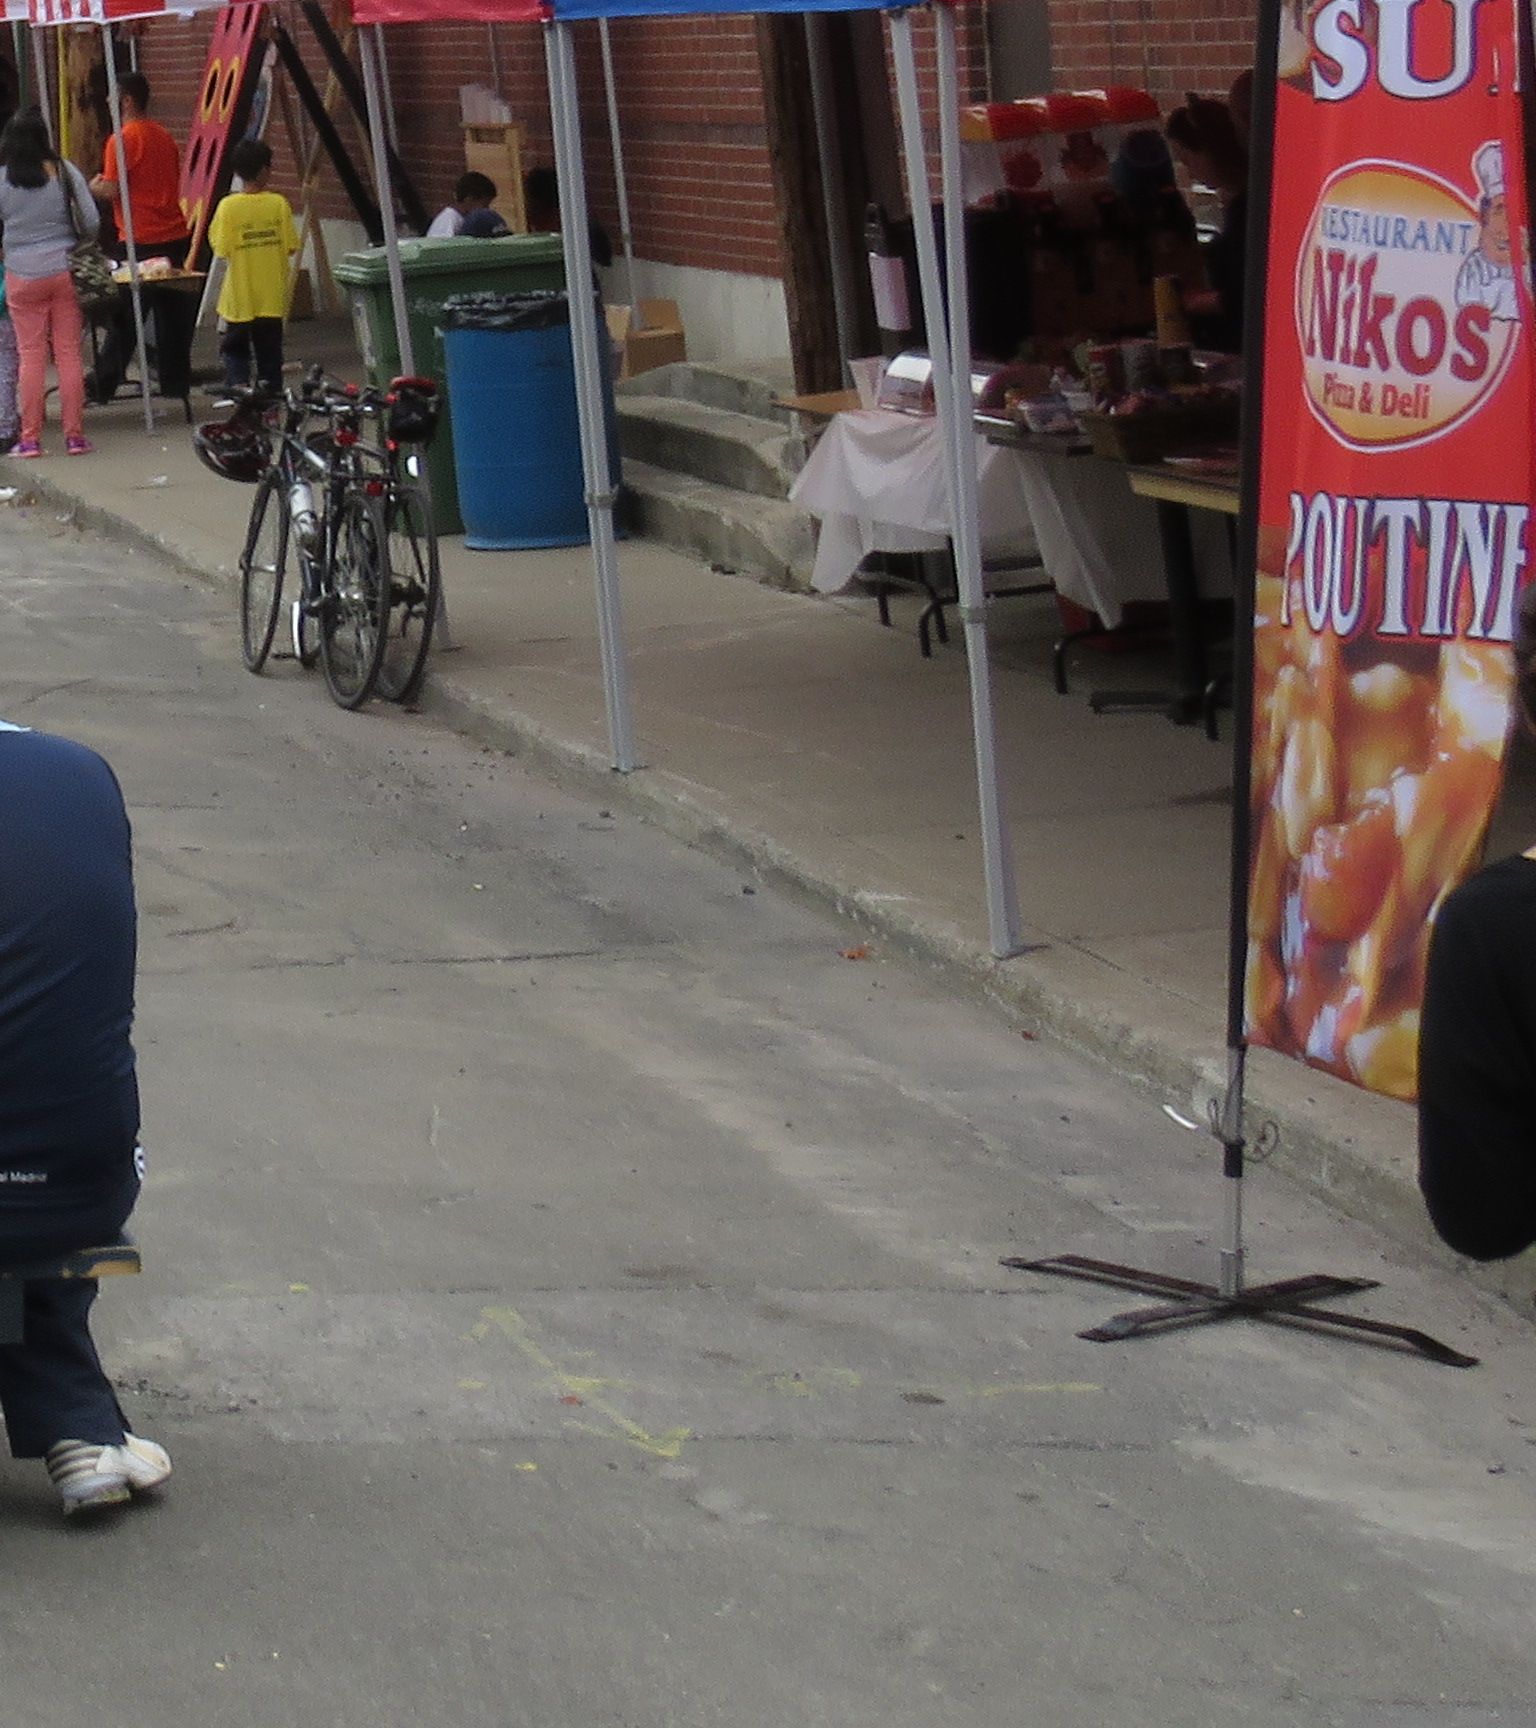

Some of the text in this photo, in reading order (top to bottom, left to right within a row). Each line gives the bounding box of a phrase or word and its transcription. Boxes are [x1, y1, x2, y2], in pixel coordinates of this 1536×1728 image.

[1306, 245, 1490, 382] Nikos
[1359, 381, 1371, 413] &
[1381, 383, 1430, 419] Deli
[10, 1171, 47, 1183] Madrid
